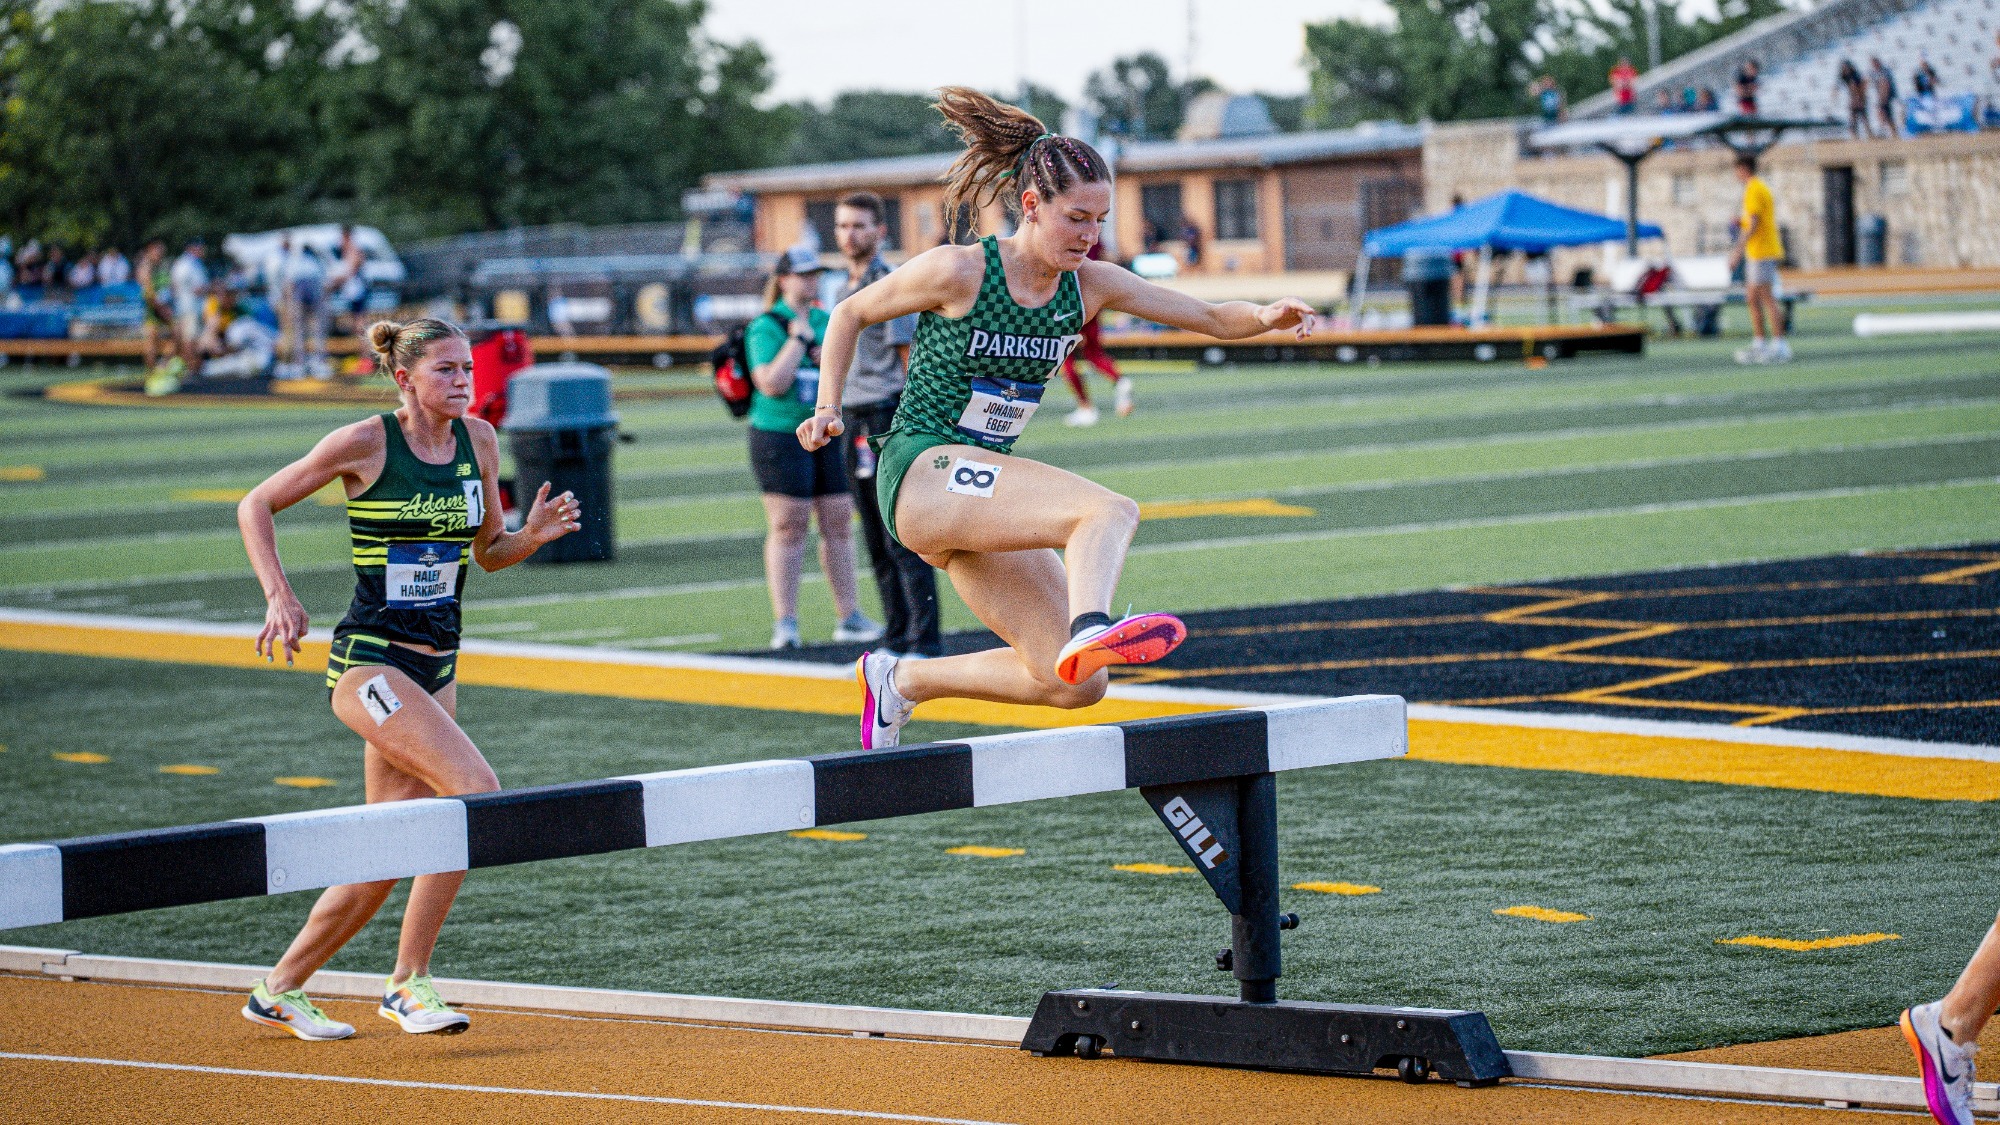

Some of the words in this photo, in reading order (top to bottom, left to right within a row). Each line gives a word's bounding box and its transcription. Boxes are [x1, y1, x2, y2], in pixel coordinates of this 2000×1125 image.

[966, 328, 1061, 361] PARKSID
[983, 401, 1025, 420] JOHANNA
[985, 417, 1014, 434] EBERT
[954, 467, 995, 489] 8
[471, 484, 482, 524] 1
[427, 513, 472, 537] Sta
[413, 569, 442, 583] HALEY
[401, 582, 447, 598] HARKRIDER
[367, 683, 392, 716] 1
[1162, 796, 1227, 870] GILL
